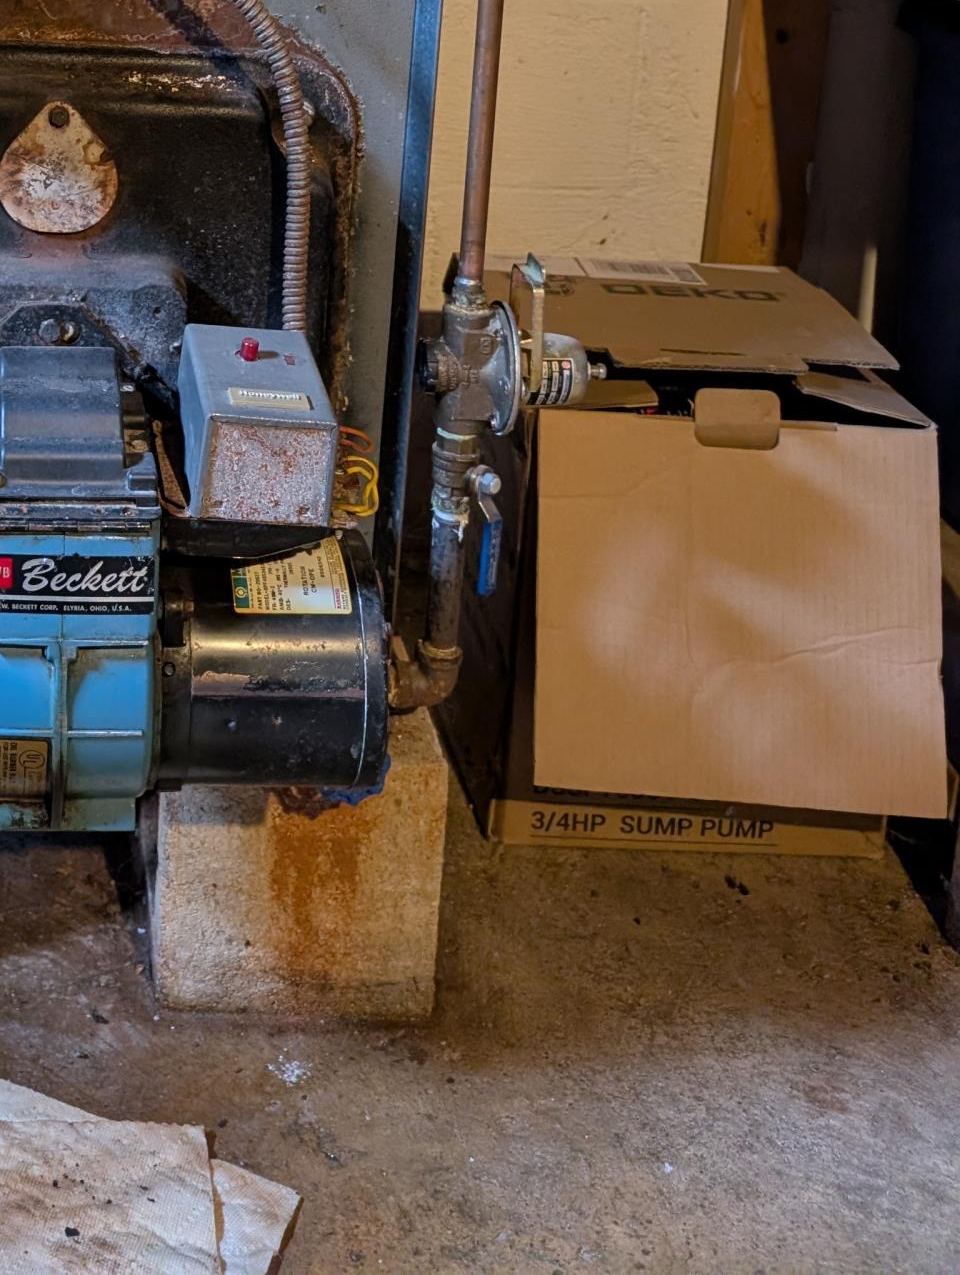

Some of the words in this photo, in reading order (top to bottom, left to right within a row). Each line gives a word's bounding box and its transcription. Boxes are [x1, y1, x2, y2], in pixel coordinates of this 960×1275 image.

[600, 283, 781, 302] DEKO
[20, 558, 149, 593] Beckett
[300, 566, 310, 596] ROTATION
[11, 603, 38, 611] BECKETT
[63, 604, 88, 613] ELYRIA,
[89, 605, 110, 613] OHIO,
[111, 605, 132, 613] U.S.A.
[530, 810, 607, 833] 3/4HP
[619, 816, 694, 837] SUMP
[700, 818, 775, 839] PUMP
